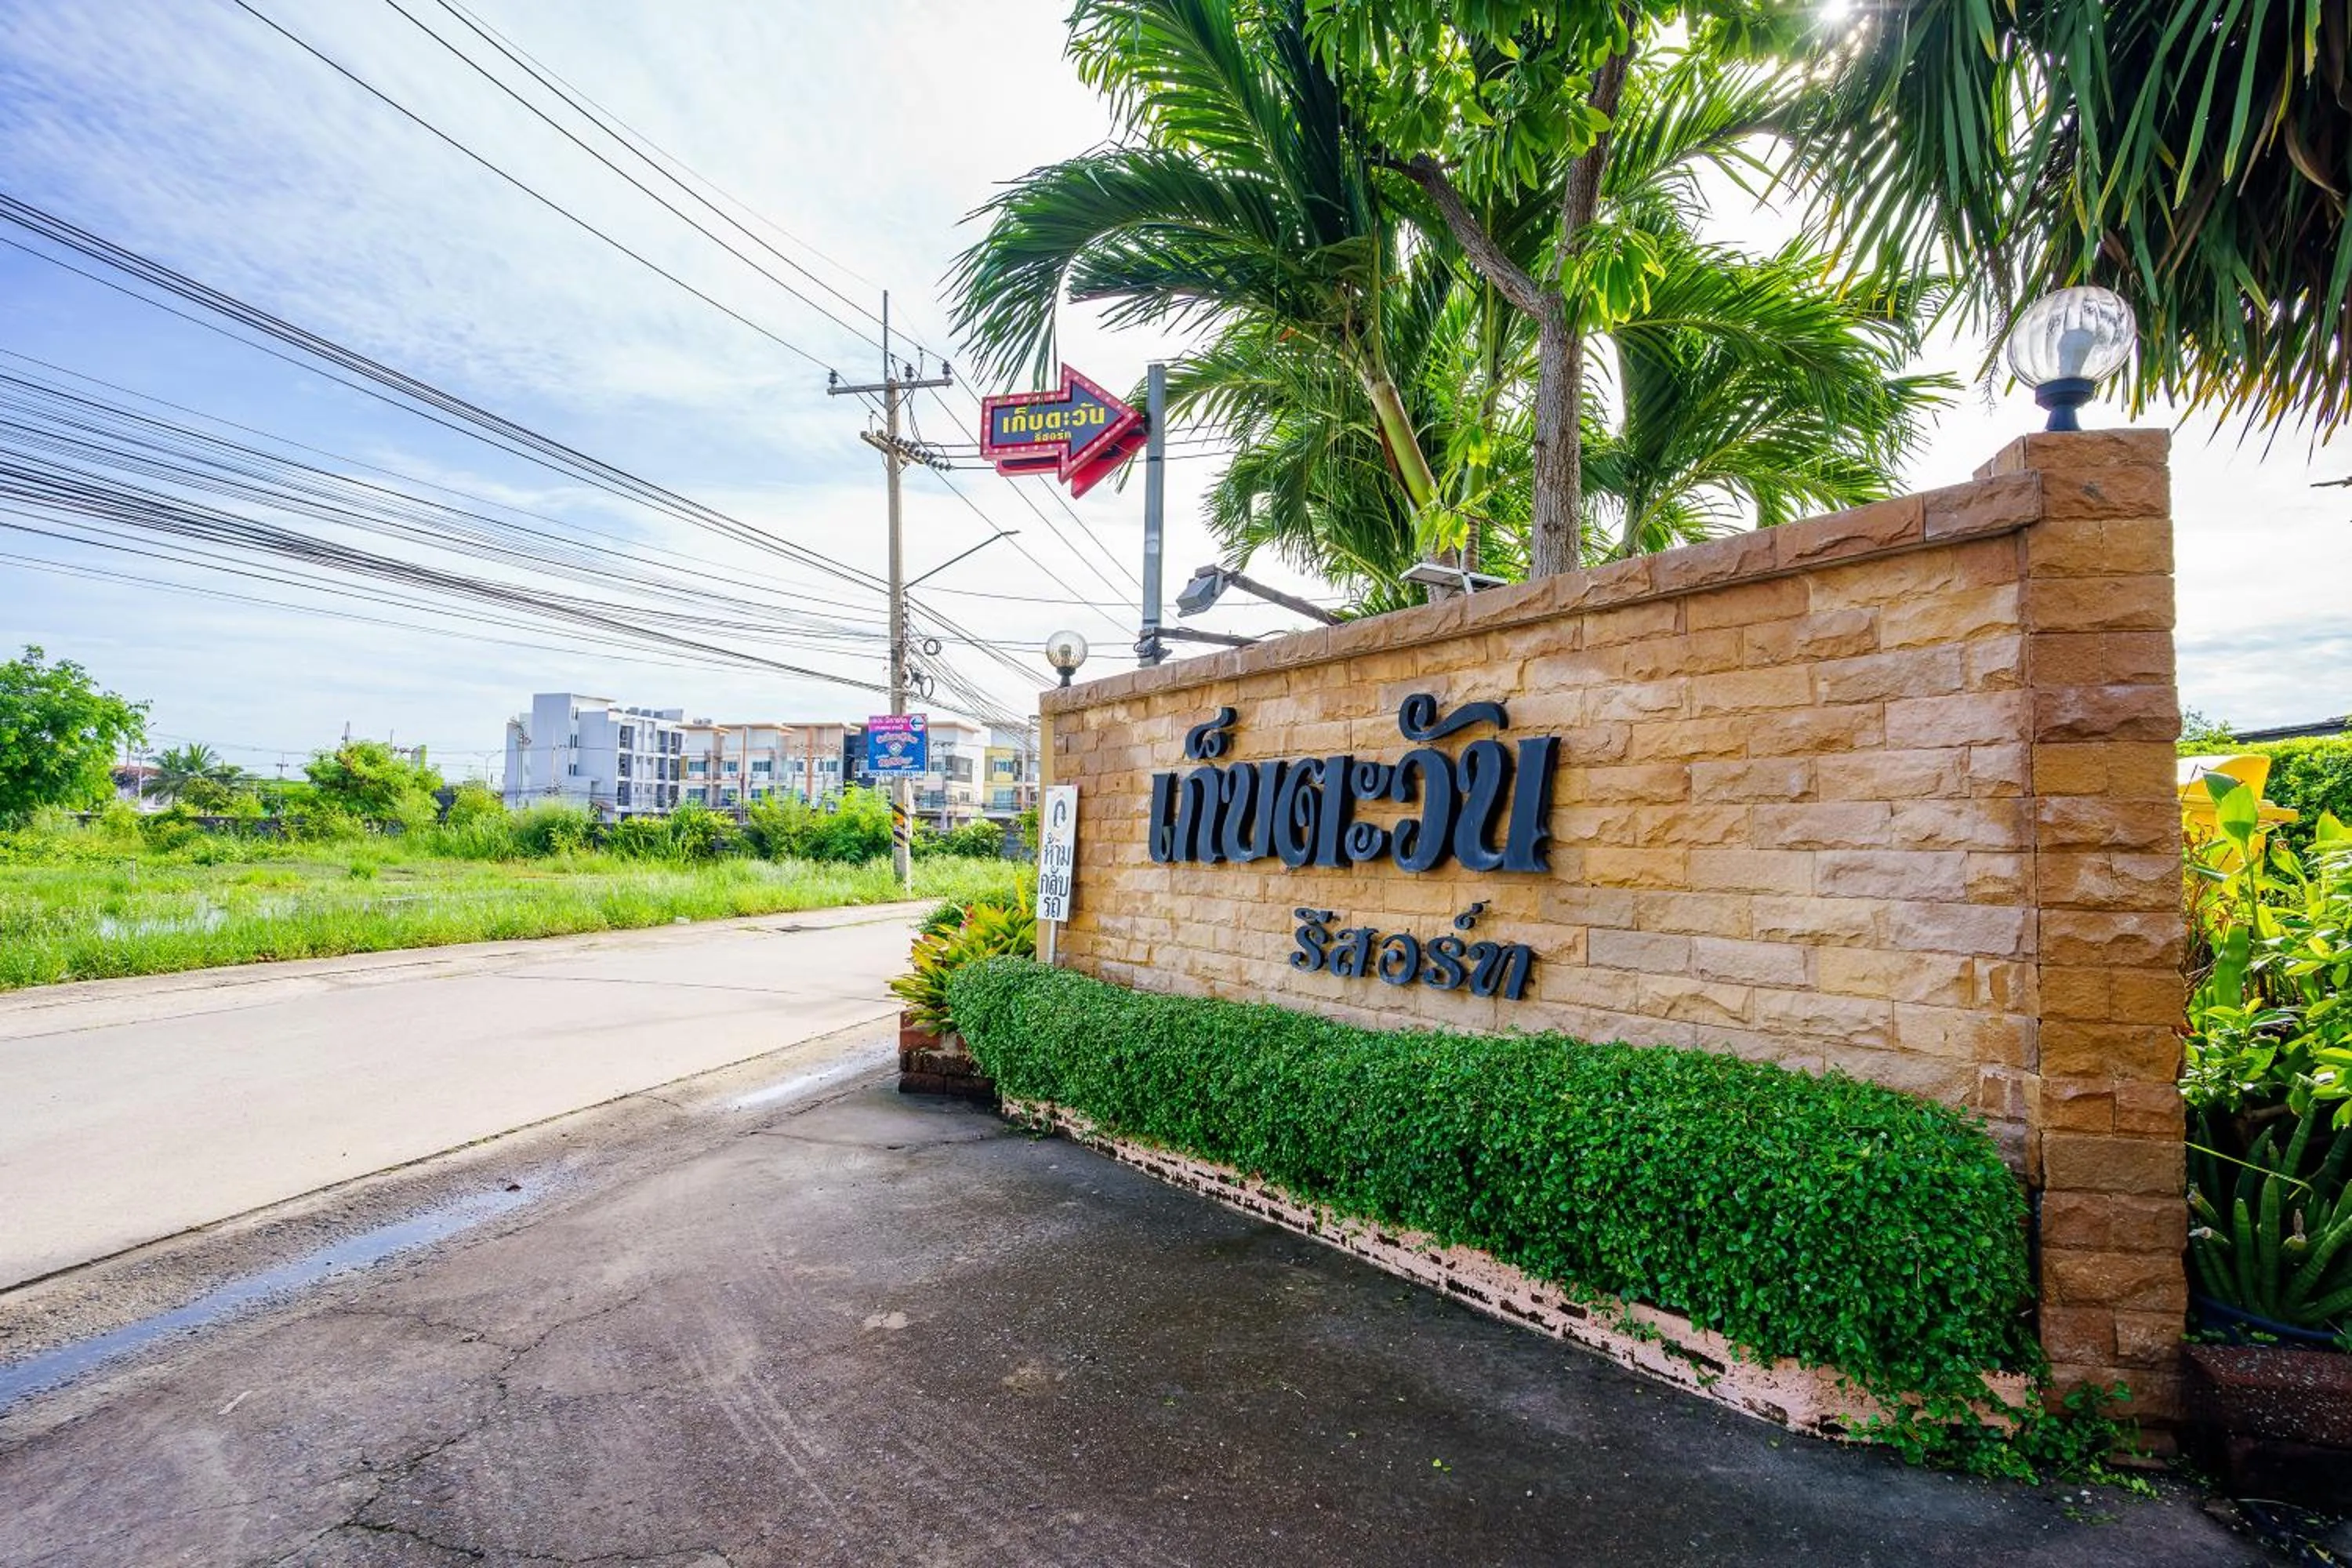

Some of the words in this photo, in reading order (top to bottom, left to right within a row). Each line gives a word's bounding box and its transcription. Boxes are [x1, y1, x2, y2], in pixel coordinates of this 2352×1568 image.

[1002, 402, 1105, 434] เก็บตะวัน
[1149, 693, 1562, 873] เก็บตะวัน
[1044, 832, 1072, 866] ห้าม
[1040, 866, 1070, 898] กลับ
[1044, 897, 1061, 918] รถ
[1290, 901, 1533, 1001] รีสอร์ท
